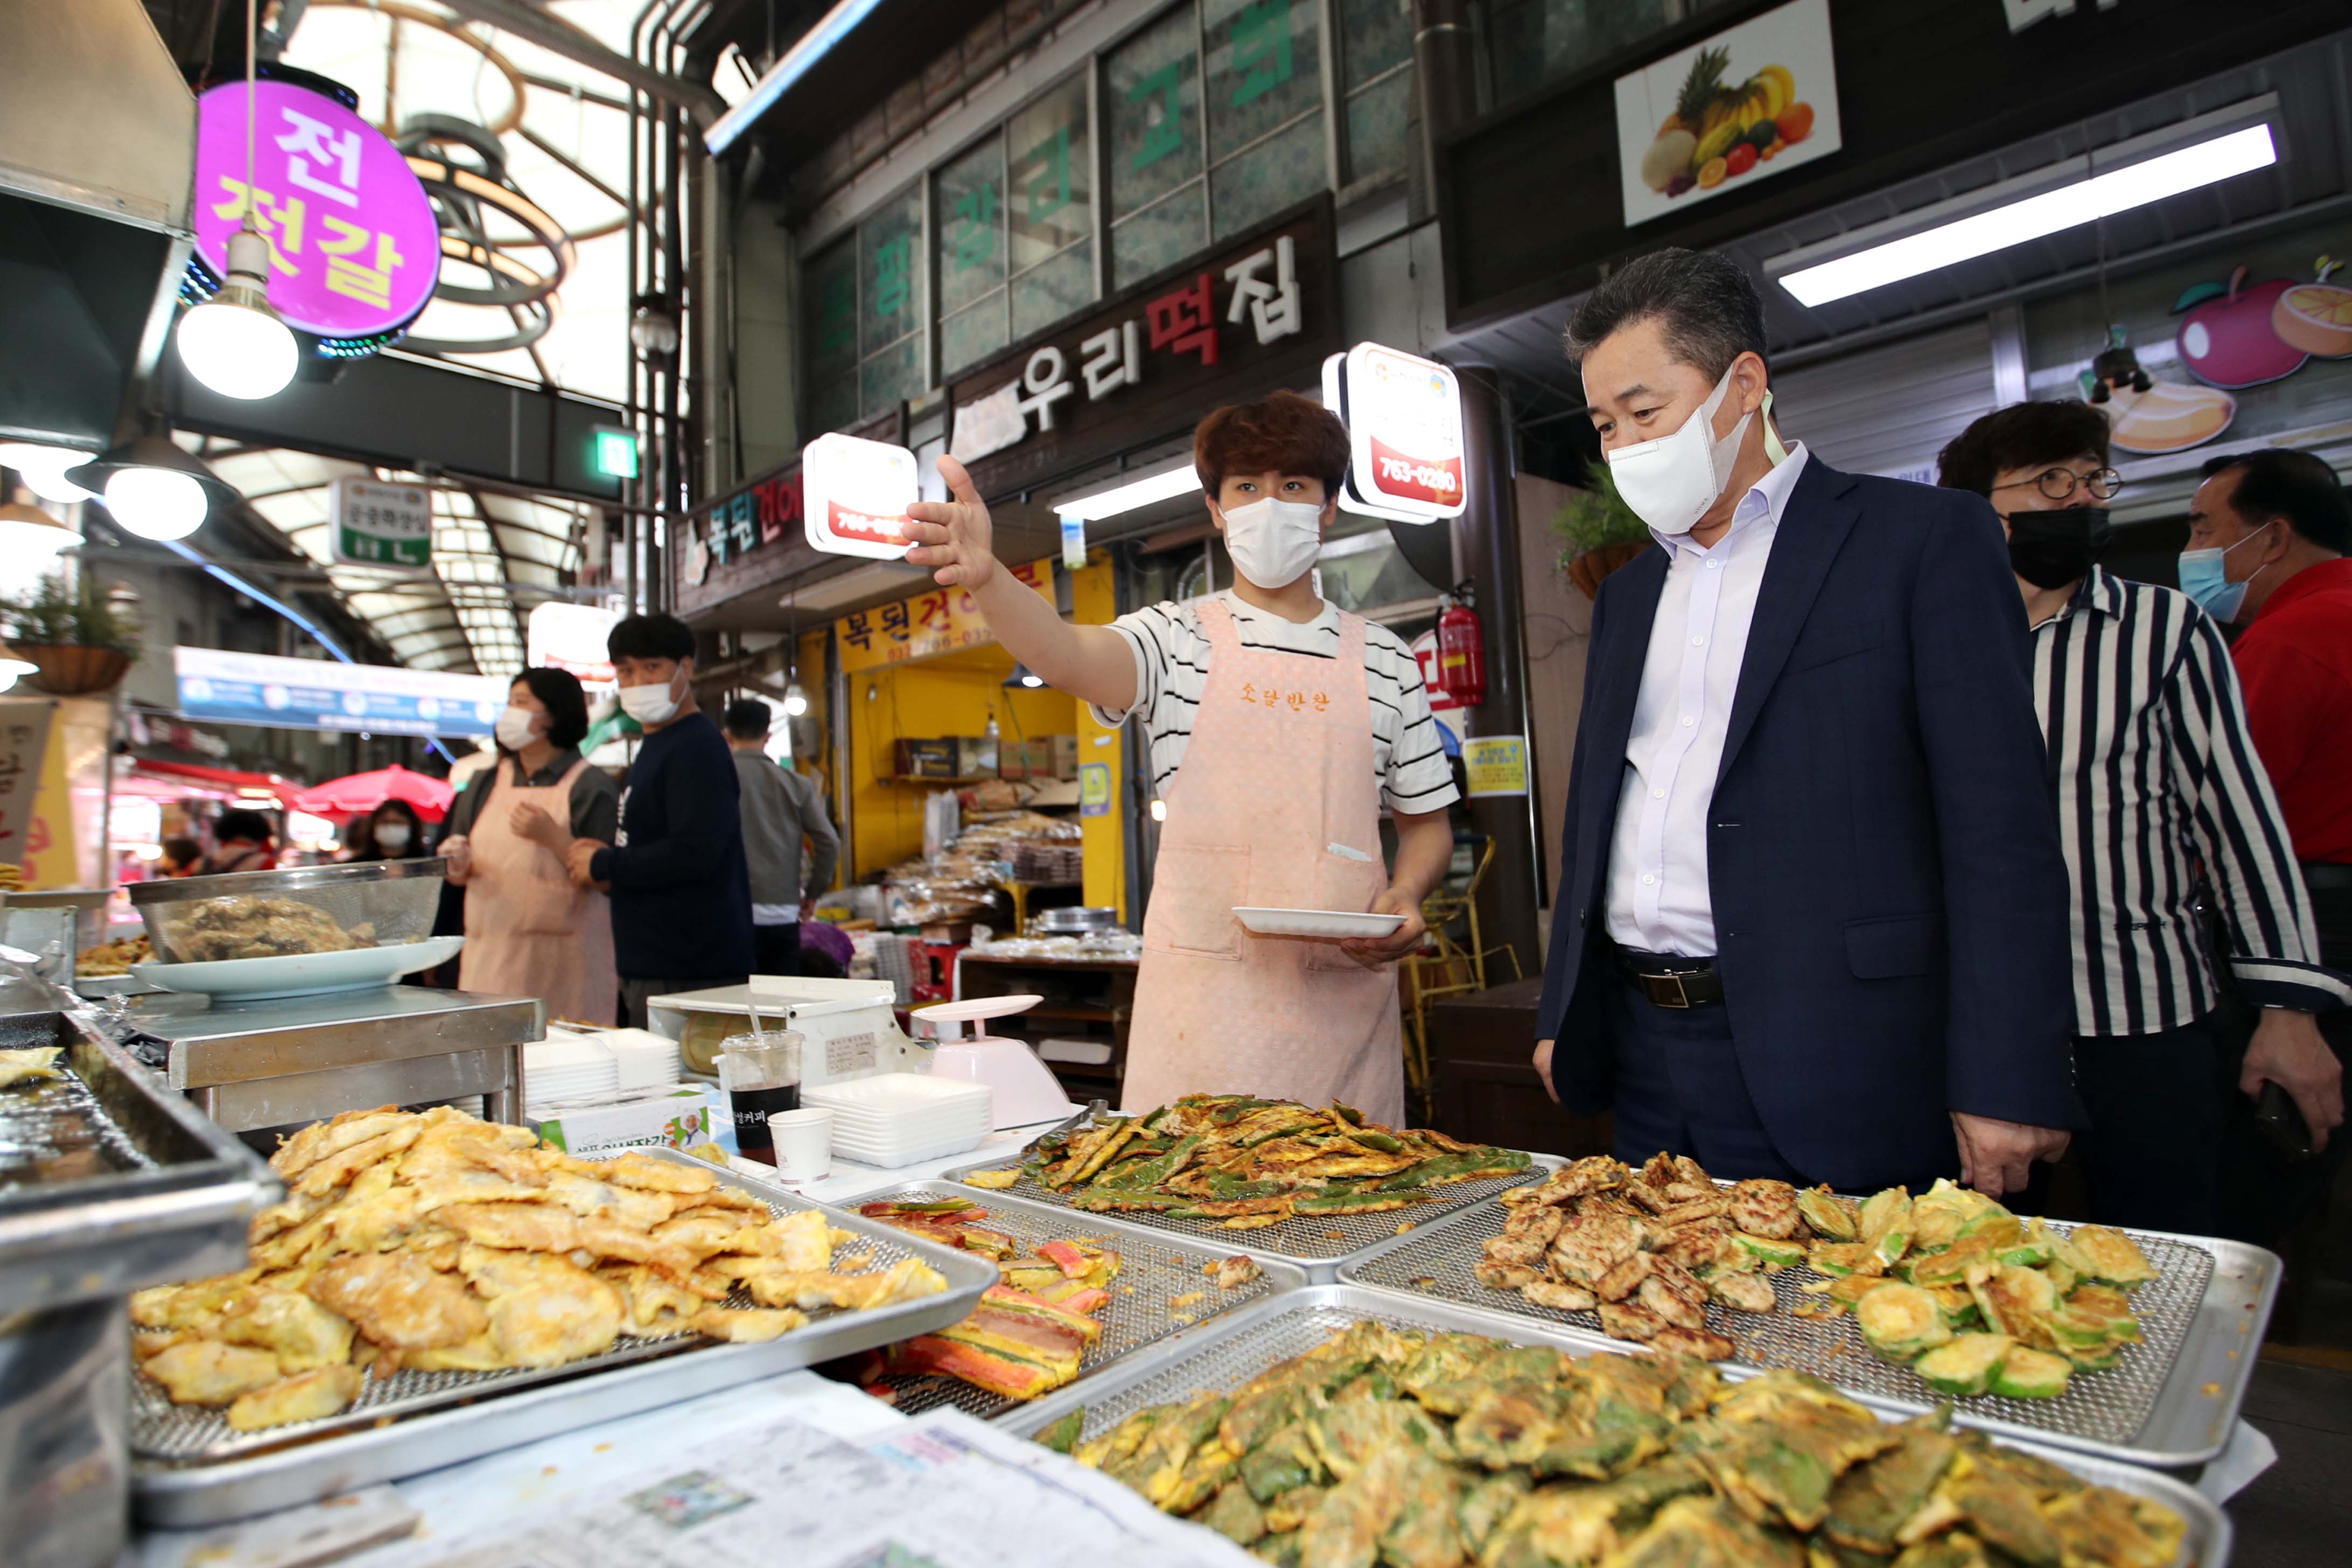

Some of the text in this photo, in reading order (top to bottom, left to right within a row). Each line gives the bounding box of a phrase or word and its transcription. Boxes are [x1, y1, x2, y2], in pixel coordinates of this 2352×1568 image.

[274, 106, 363, 209] 전
[211, 174, 405, 310] 젓갈
[1019, 234, 1302, 432] 우리떡집
